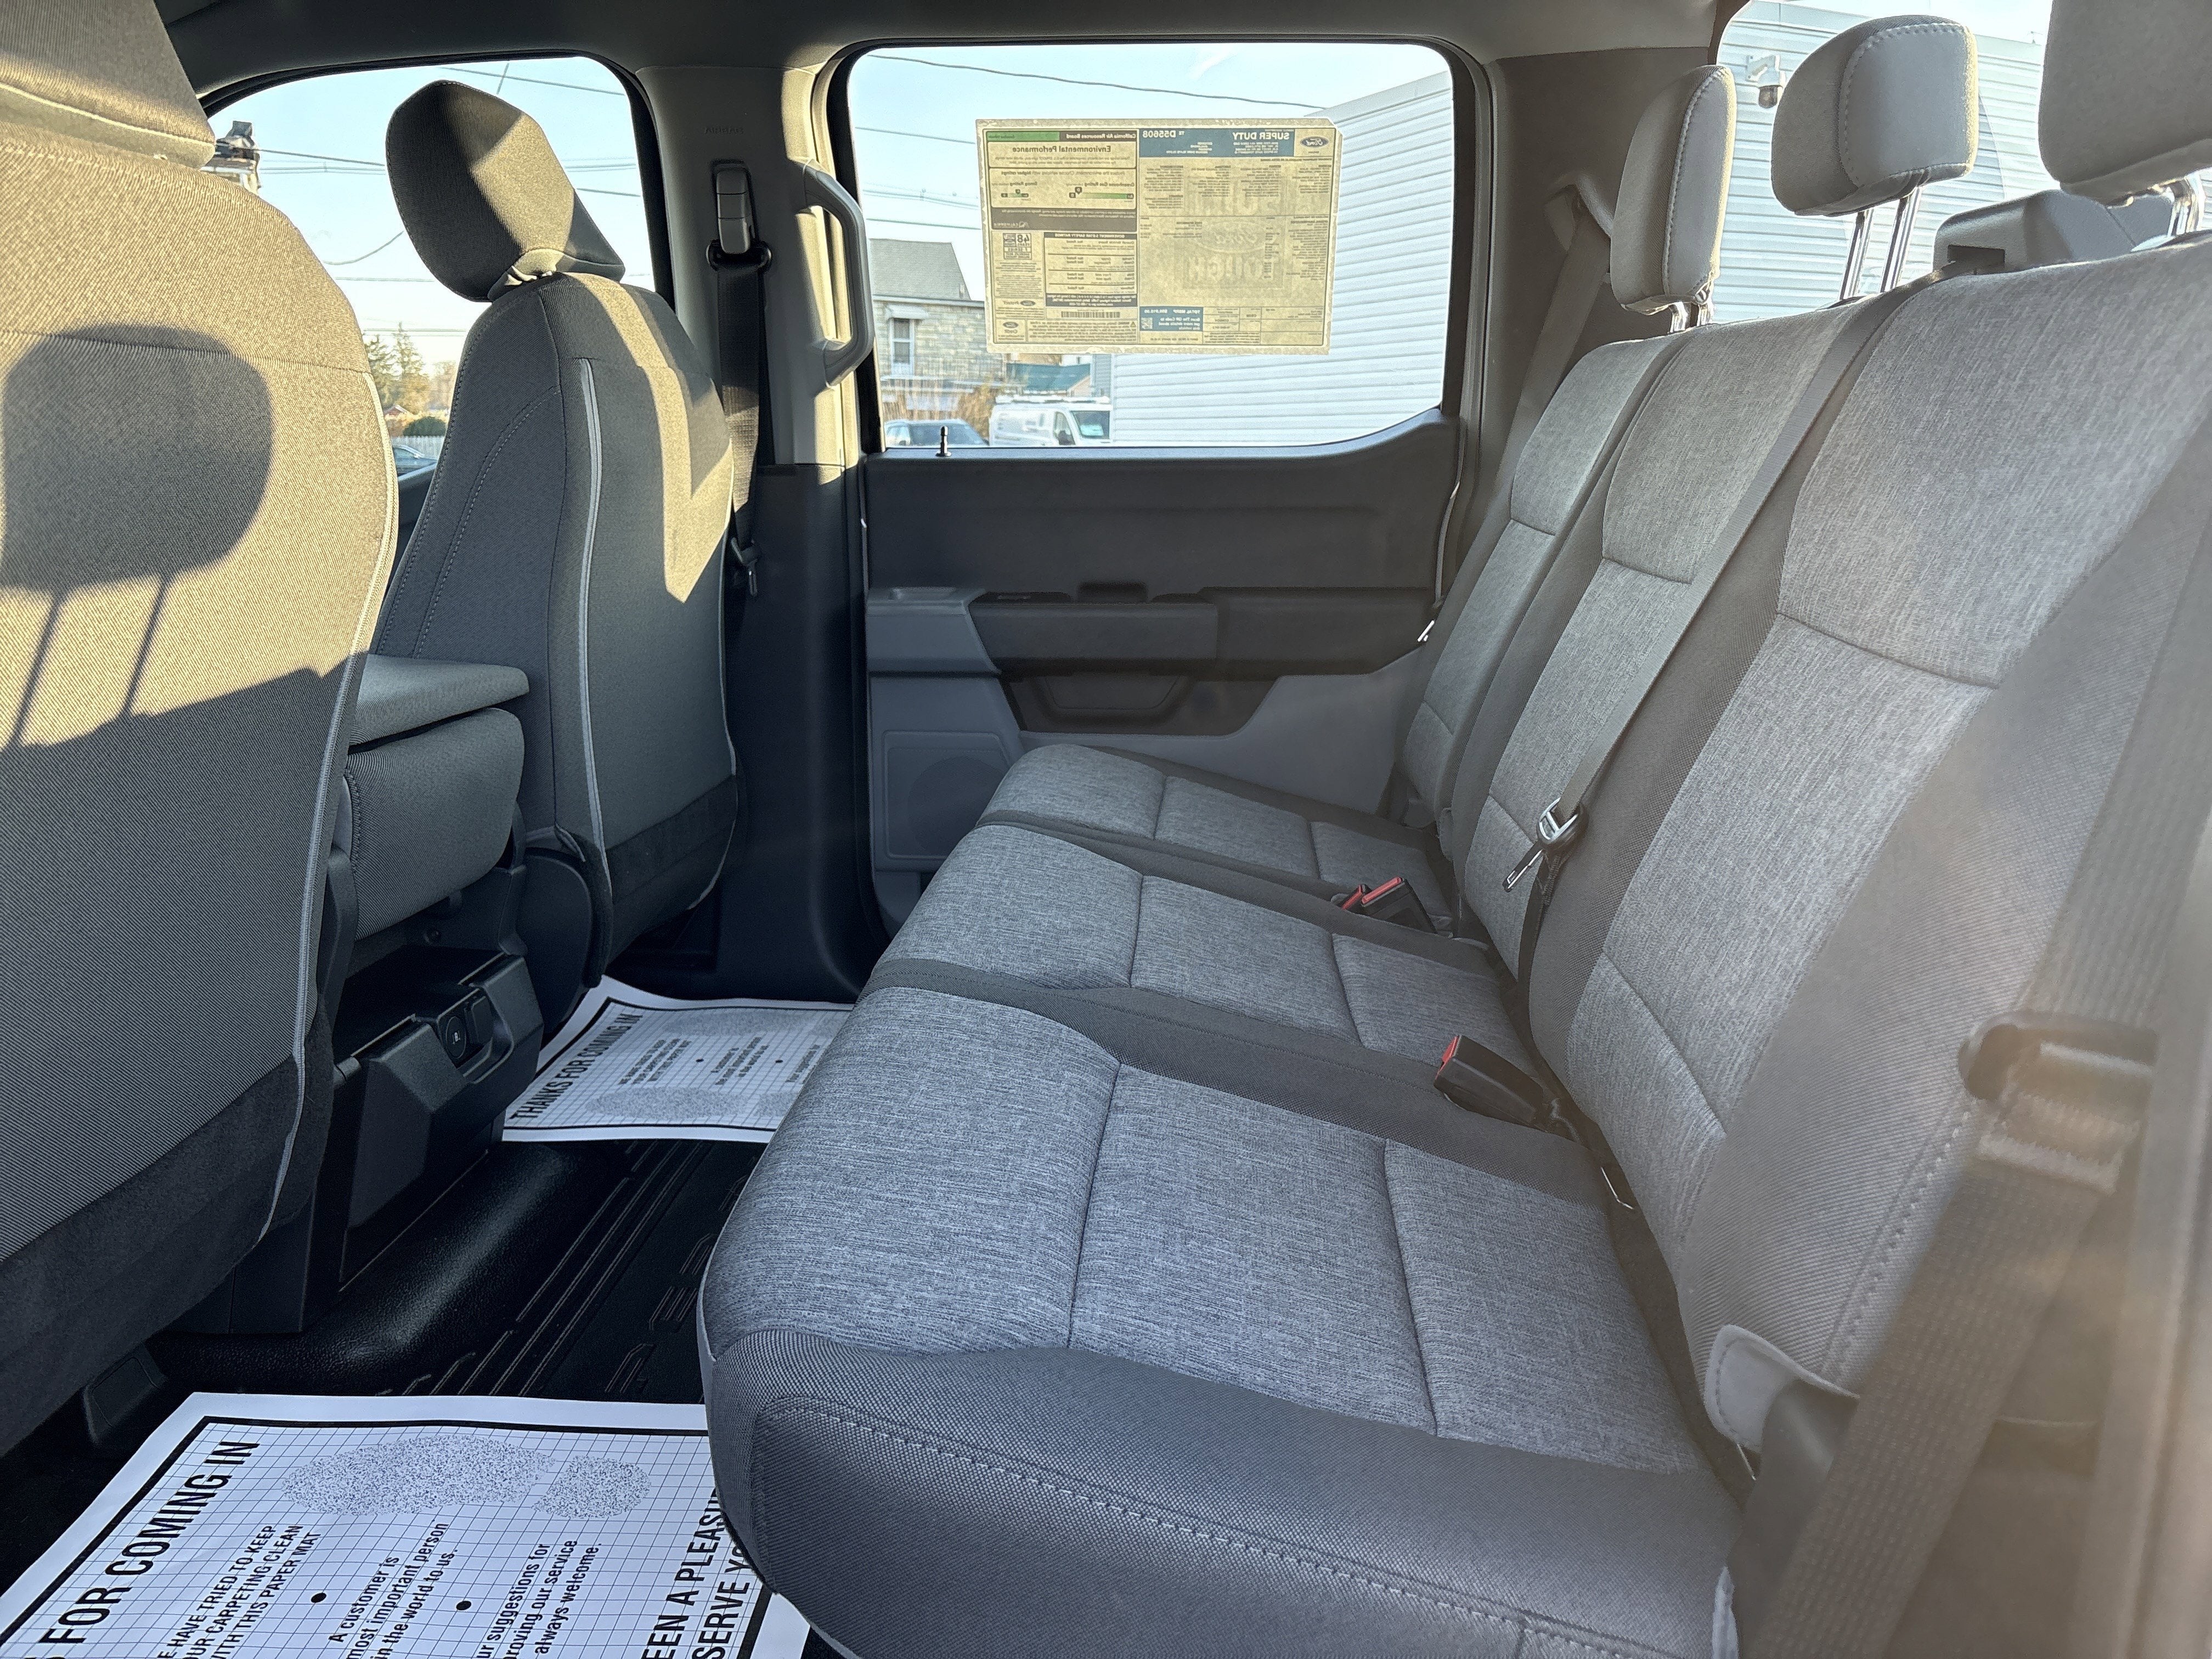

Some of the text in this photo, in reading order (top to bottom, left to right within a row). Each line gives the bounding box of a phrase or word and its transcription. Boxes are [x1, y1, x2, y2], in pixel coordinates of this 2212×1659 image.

[508, 1081, 574, 1120] THANKS
[555, 1059, 596, 1079] FOR
[38, 1587, 134, 1644] FOR
[105, 1474, 233, 1576] COMING
[203, 1441, 261, 1465] IN
[167, 1615, 207, 1647] HAVE
[196, 1575, 238, 1611] TRIED
[228, 1557, 253, 1572] TO
[244, 1525, 276, 1553] KEEP
[205, 1565, 273, 1634] CARPETING
[263, 1526, 303, 1562] CLEAN
[233, 1602, 269, 1630] THIS
[258, 1559, 302, 1598] PAPER
[291, 1532, 321, 1556] MAT
[346, 1522, 449, 1659] most important person
[531, 1588, 552, 1610] our
[544, 1540, 578, 1584] service
[328, 1556, 400, 1643] A customer is
[382, 1623, 409, 1644] the
[400, 1585, 435, 1620] world
[423, 1570, 444, 1582] to
[436, 1549, 459, 1567] us.
[486, 1563, 540, 1641] suggestions
[527, 1543, 550, 1560] for
[534, 1543, 602, 1654] always welcome.
[640, 1615, 690, 1659] EEN
[665, 1590, 700, 1606] A
[691, 1581, 751, 1659] SERVE
